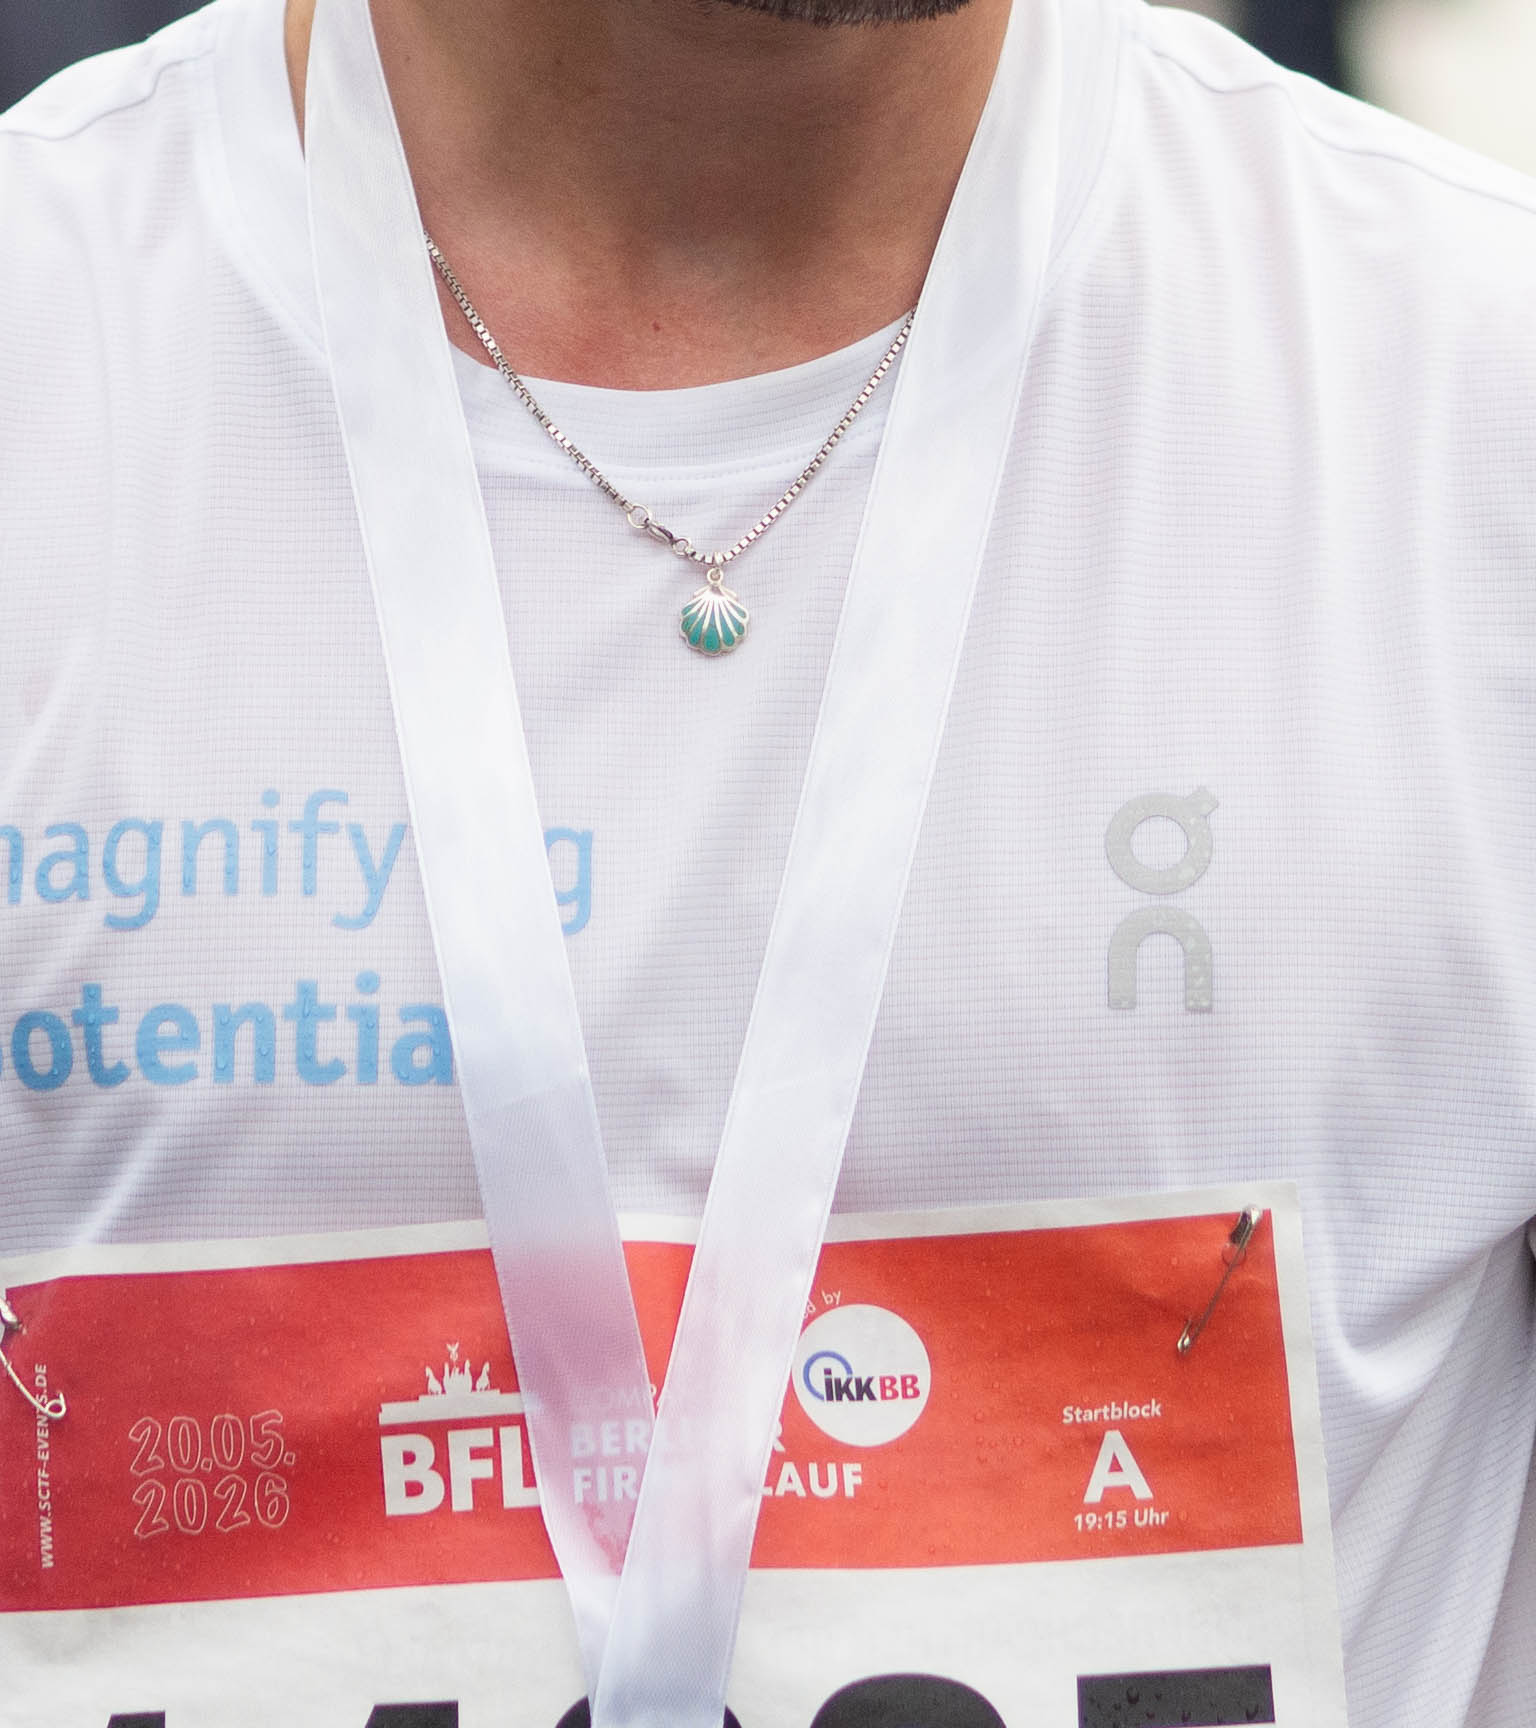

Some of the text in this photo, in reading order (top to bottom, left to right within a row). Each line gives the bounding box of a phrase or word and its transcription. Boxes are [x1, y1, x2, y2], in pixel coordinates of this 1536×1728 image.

[821, 1289, 842, 1305] by
[128, 1409, 296, 1475] 20.05.
[1062, 1398, 1162, 1424] Startblock
[380, 1425, 543, 1517] BFL
[1083, 1429, 1155, 1504] A
[132, 1472, 291, 1538] 2026
[1074, 1506, 1170, 1532] 19:15 Uhr
